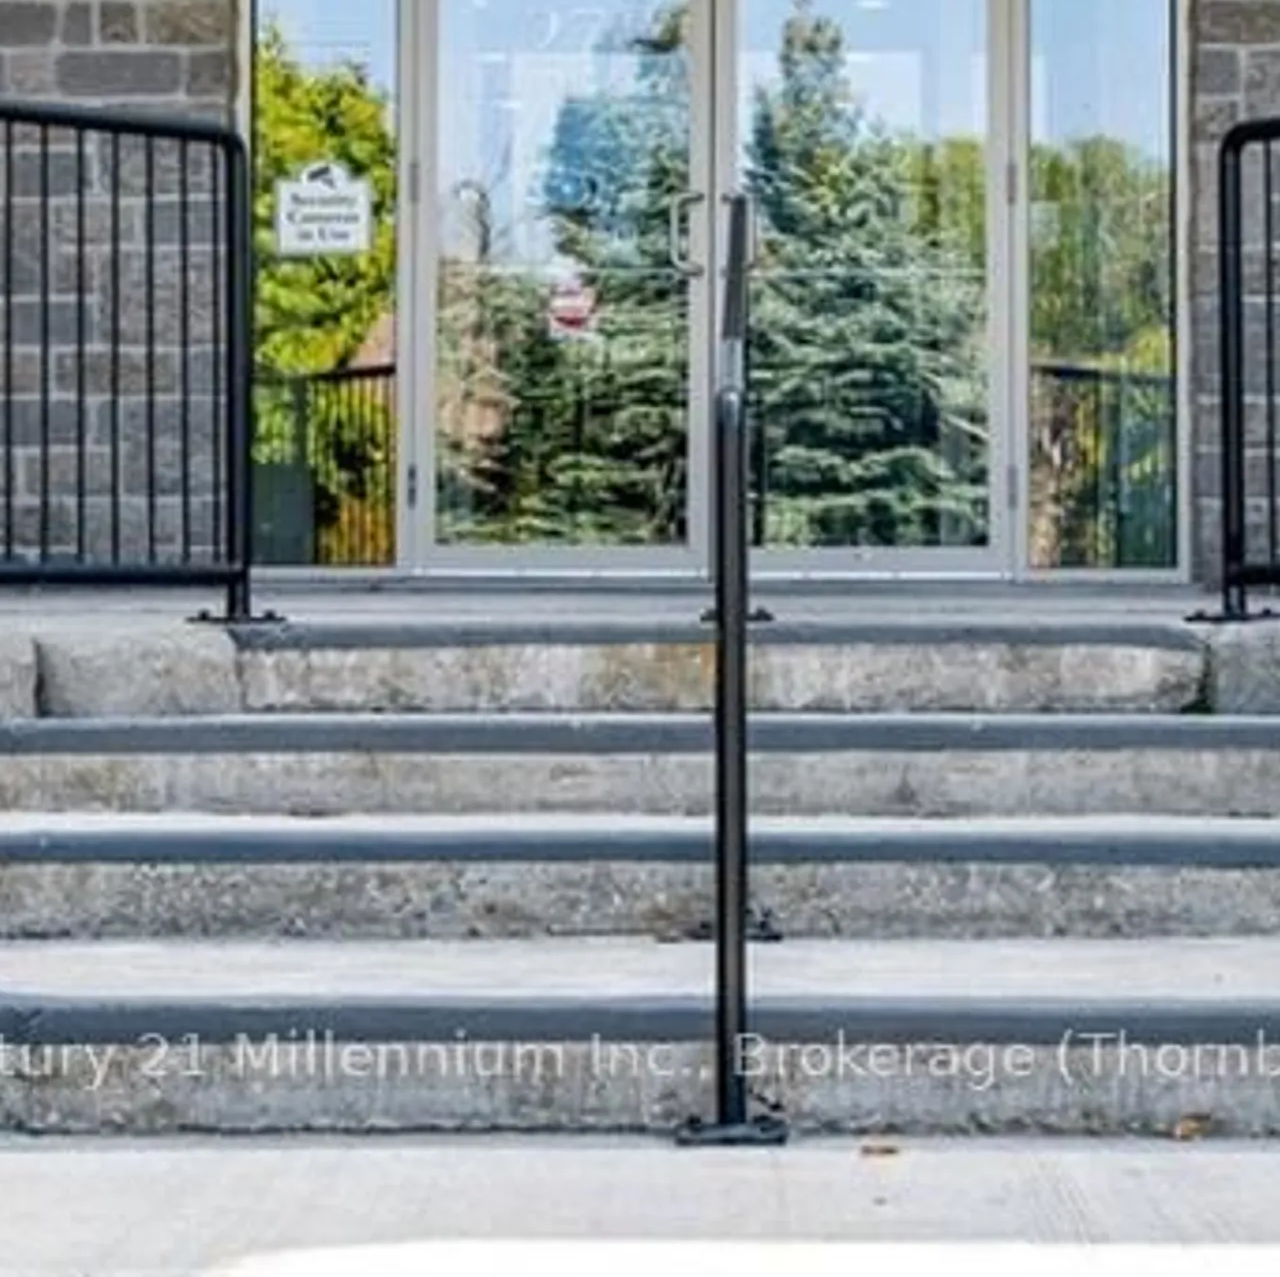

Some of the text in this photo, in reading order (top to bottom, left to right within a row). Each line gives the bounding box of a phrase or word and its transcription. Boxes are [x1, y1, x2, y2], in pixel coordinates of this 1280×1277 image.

[290, 193, 358, 207] Security
[286, 211, 361, 224] Cameras
[317, 226, 350, 241] Use
